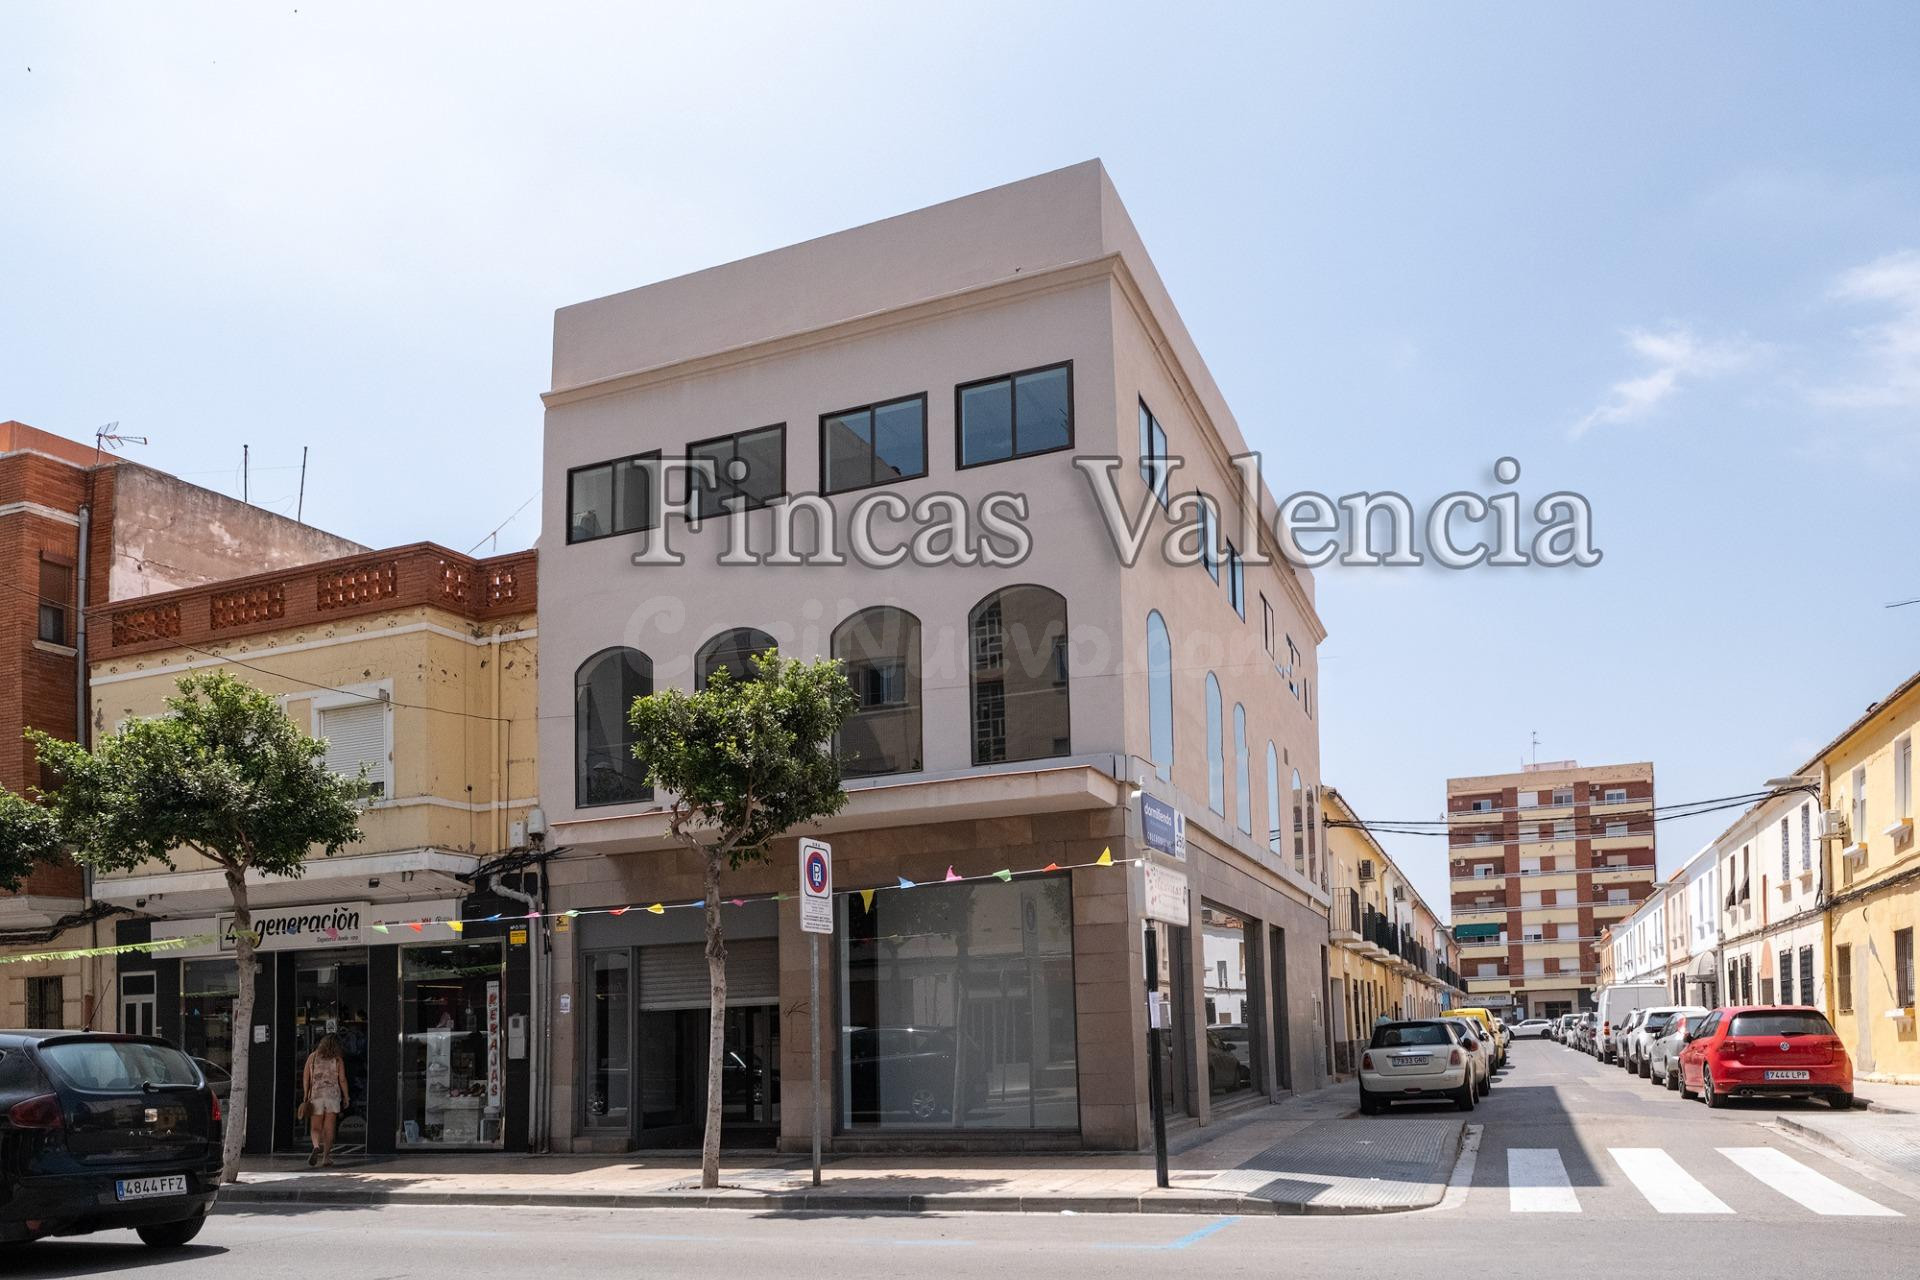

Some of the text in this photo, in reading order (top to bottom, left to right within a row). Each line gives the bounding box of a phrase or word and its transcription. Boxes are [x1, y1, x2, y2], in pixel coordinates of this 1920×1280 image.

[489, 991, 499, 1097] REBAJAS
[1770, 1071, 1807, 1079] 7444 LPP
[128, 1129, 173, 1137] ALTA
[126, 1177, 184, 1195] 4844 FFZ
